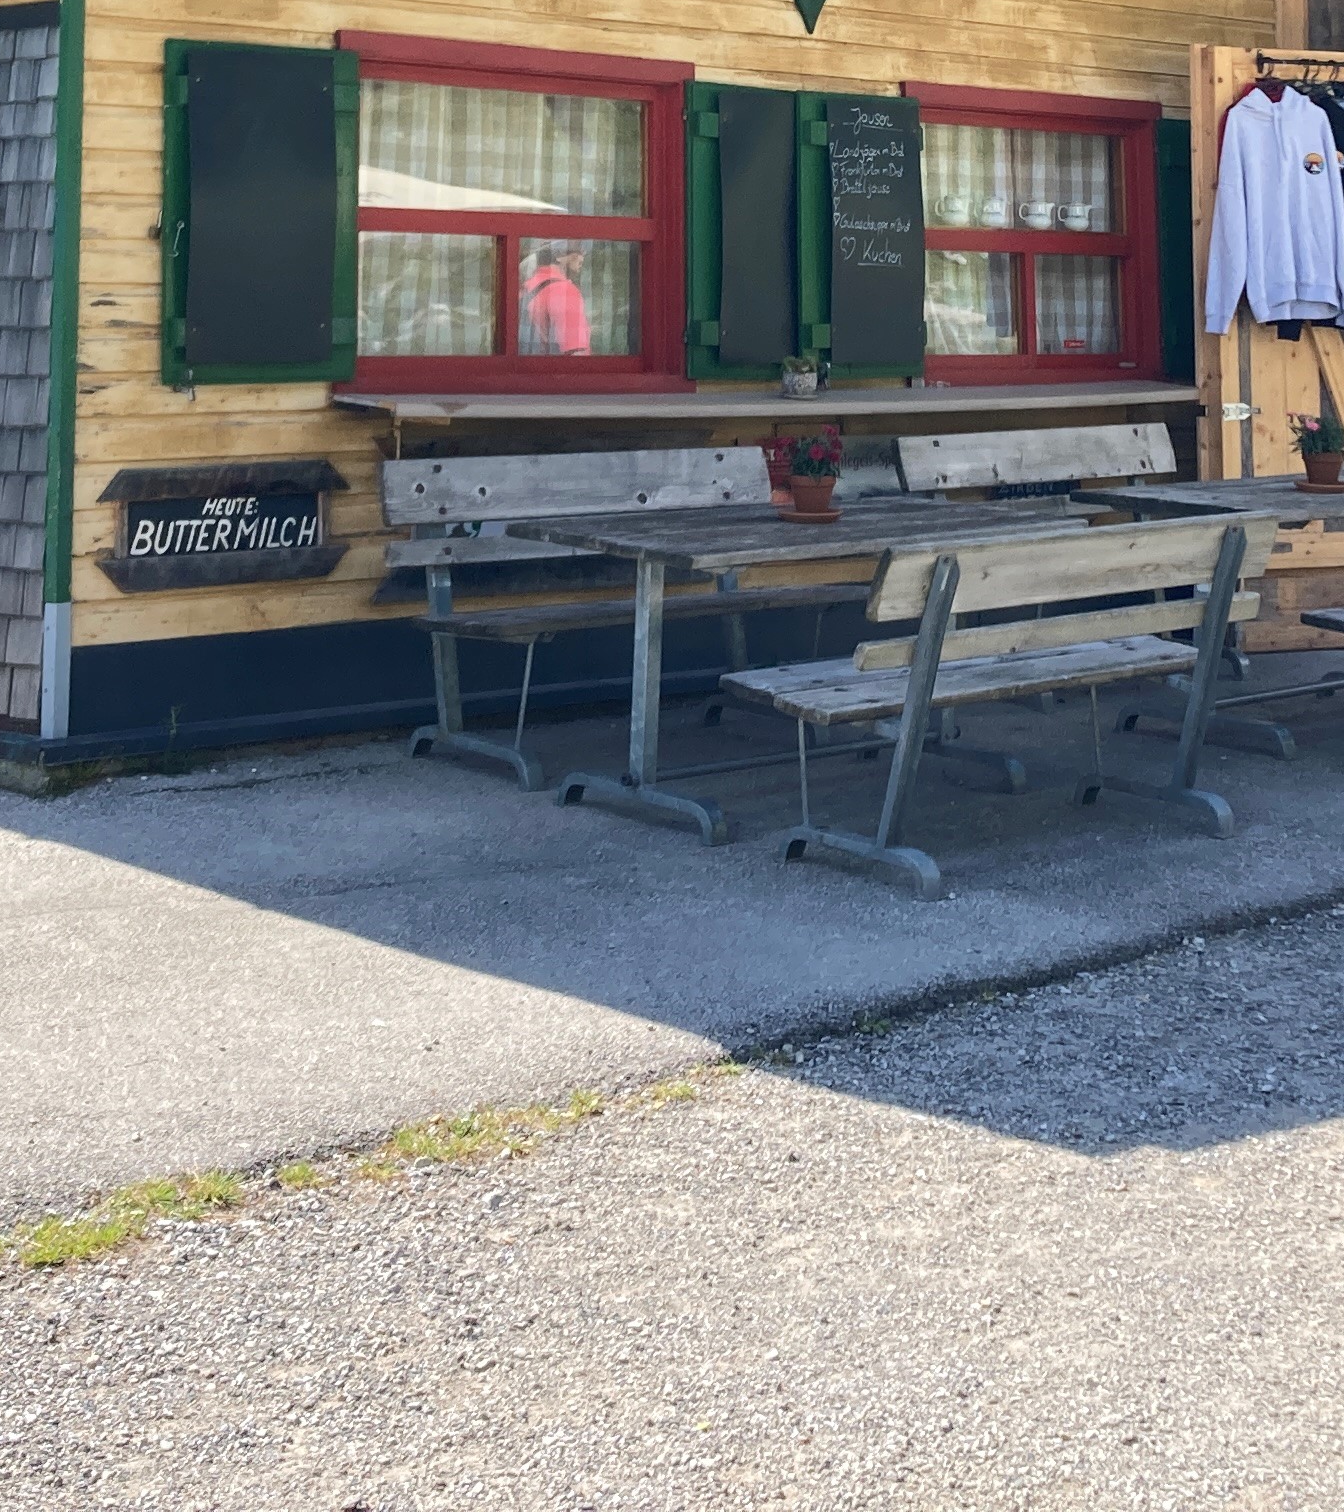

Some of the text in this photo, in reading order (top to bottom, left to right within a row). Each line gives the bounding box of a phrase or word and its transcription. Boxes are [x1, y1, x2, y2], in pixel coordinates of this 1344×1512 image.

[863, 238, 902, 265] Kuchen
[201, 497, 259, 516] HEUTE:
[130, 515, 317, 556] BUTTERMILCH
